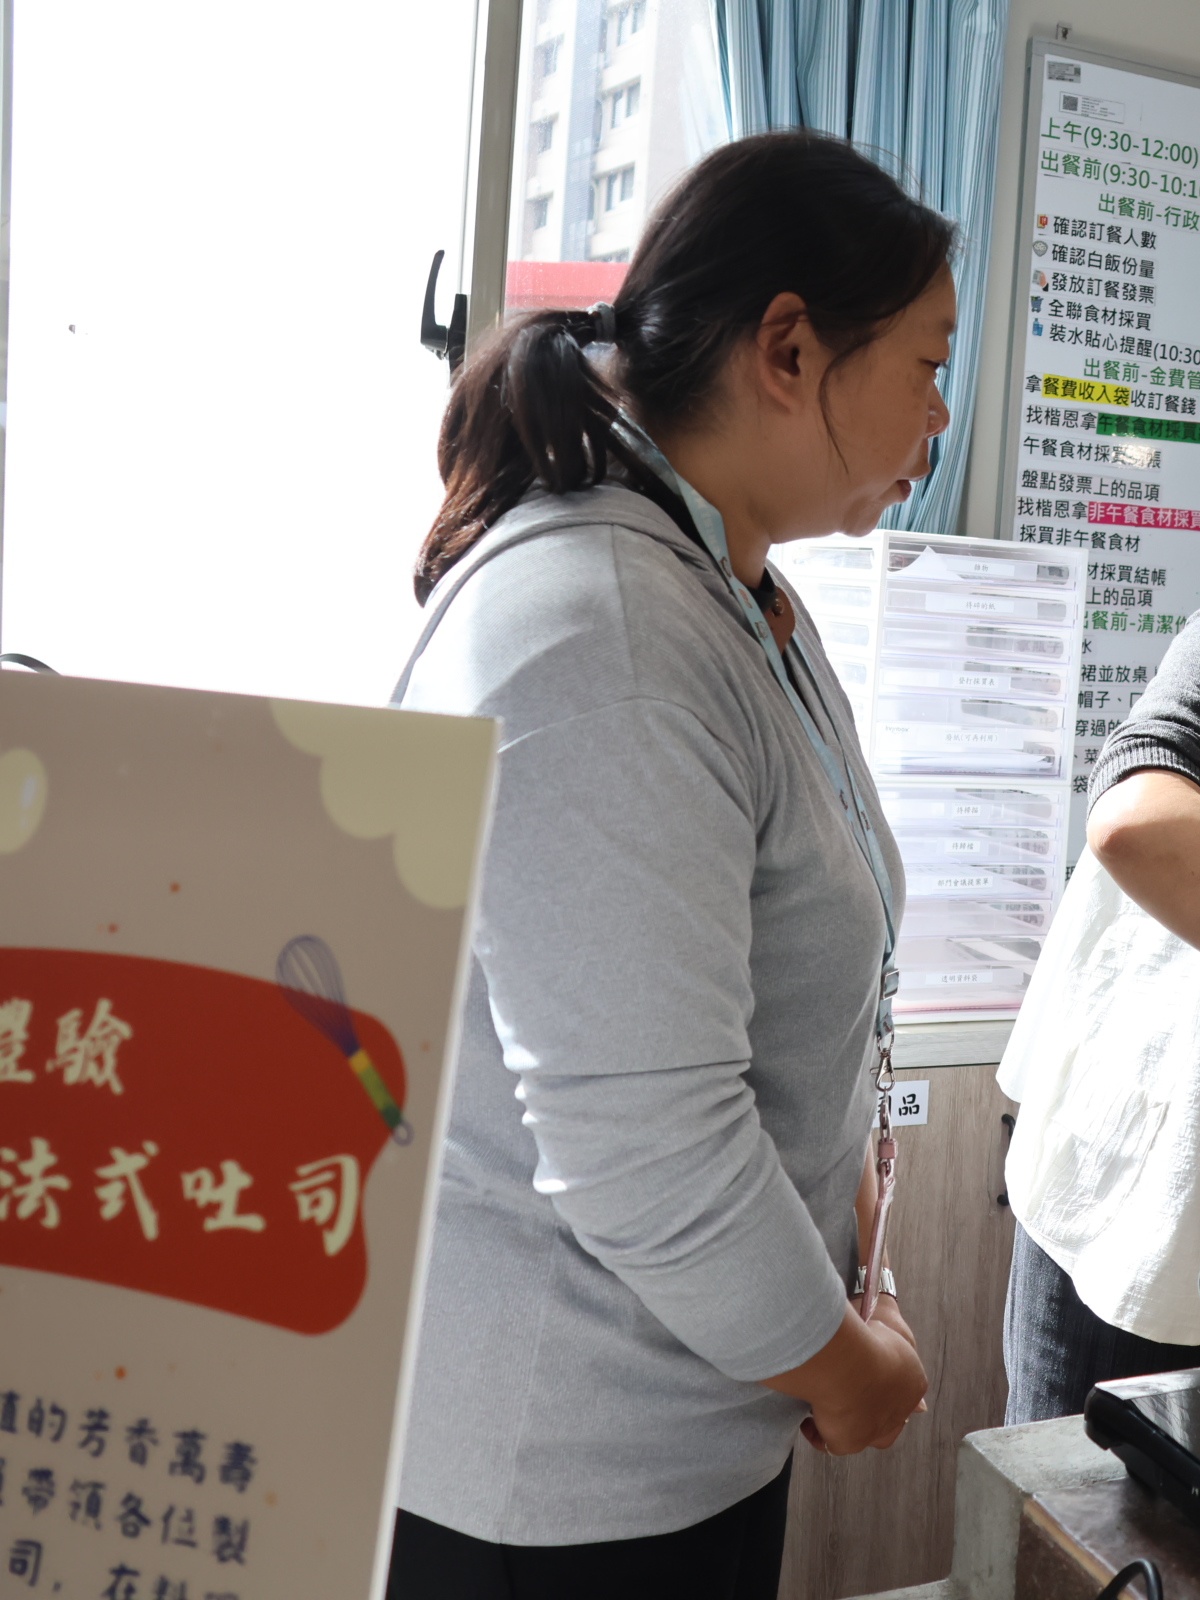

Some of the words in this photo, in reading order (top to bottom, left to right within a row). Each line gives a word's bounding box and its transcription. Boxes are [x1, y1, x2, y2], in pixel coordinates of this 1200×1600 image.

[1041, 117, 1199, 168] 上午(9:30-12:00)
[1053, 217, 1157, 250] 確認訂餐人數
[1051, 243, 1155, 279] 確認白飯份量
[1051, 273, 1155, 305] 發放訂餐發票
[1048, 299, 1152, 331] 全聯食材採買
[1025, 374, 1197, 415] 拿餐費收入袋收訂餐錢
[1024, 436, 1162, 469] 午餐食材採買帳
[1022, 470, 1160, 502] 盤點發票上的品項
[1019, 524, 1141, 552] 採買非午餐食材
[1086, 587, 1153, 607] 上的品項
[1081, 665, 1158, 683] 裙並放桌
[0, 1136, 360, 1257] 法式吐司
[0, 1457, 250, 1566] 帶領各位製
